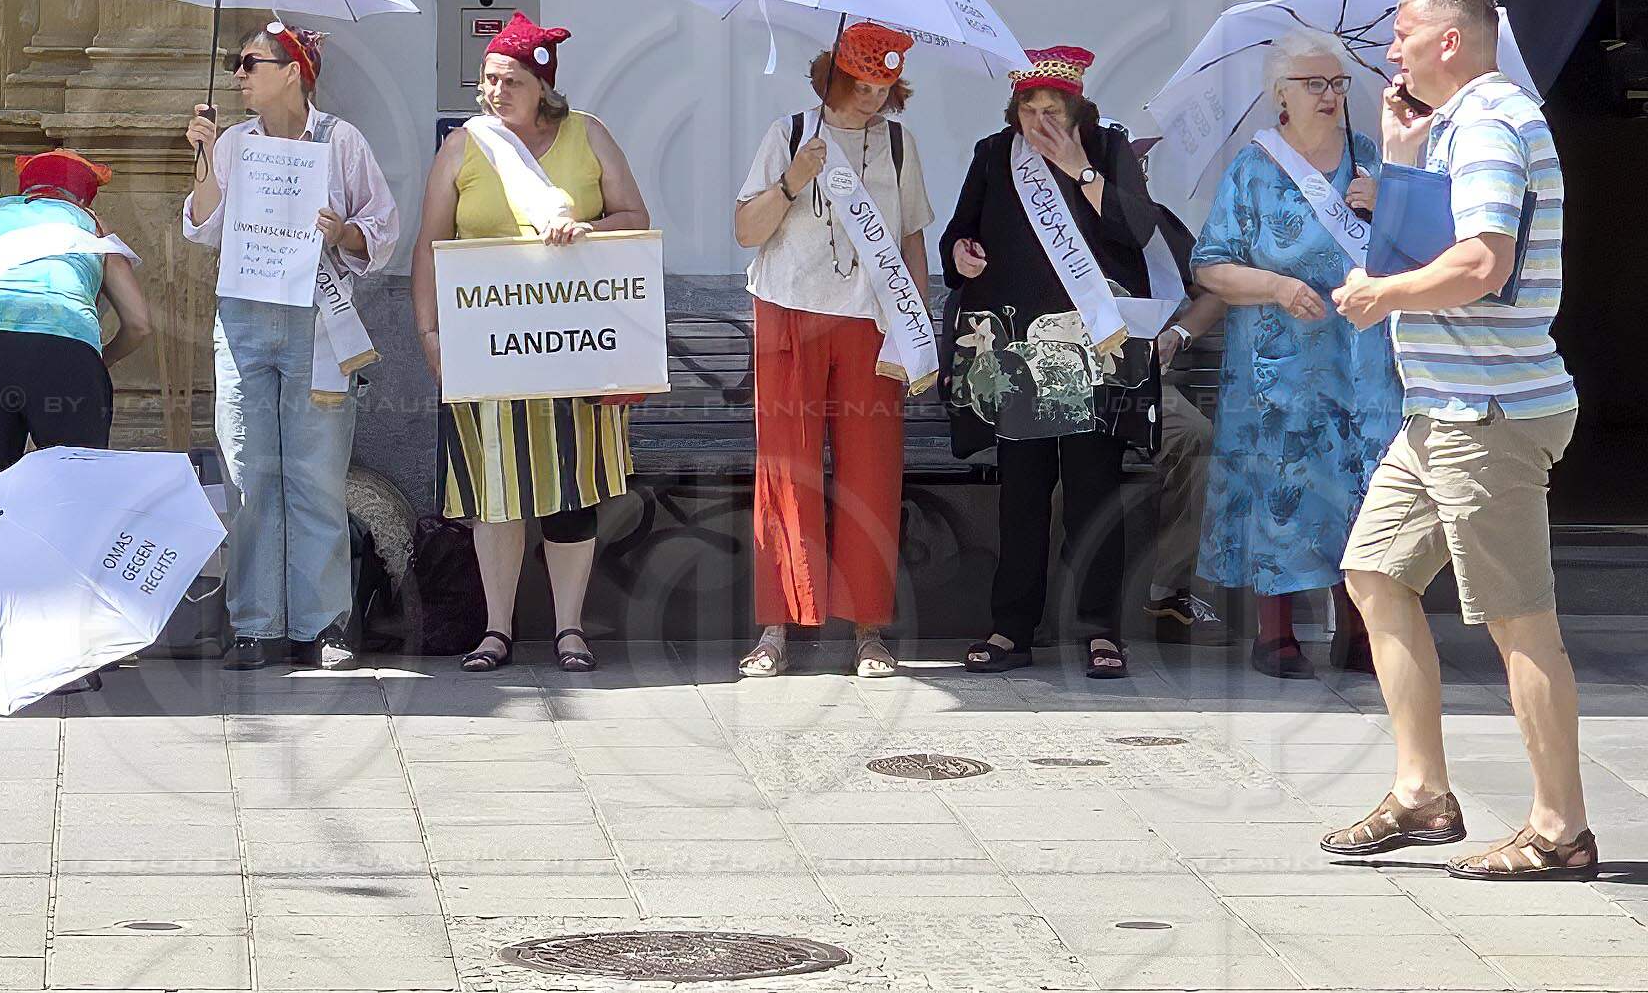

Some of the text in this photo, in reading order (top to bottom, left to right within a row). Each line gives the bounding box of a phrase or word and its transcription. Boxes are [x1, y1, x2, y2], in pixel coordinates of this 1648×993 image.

[456, 276, 646, 309] MAHNWACHE
[490, 328, 617, 356] LANDTAG
[102, 531, 133, 570] OMAS
[122, 539, 156, 582] GEGEN
[139, 548, 178, 595] RECHTS
